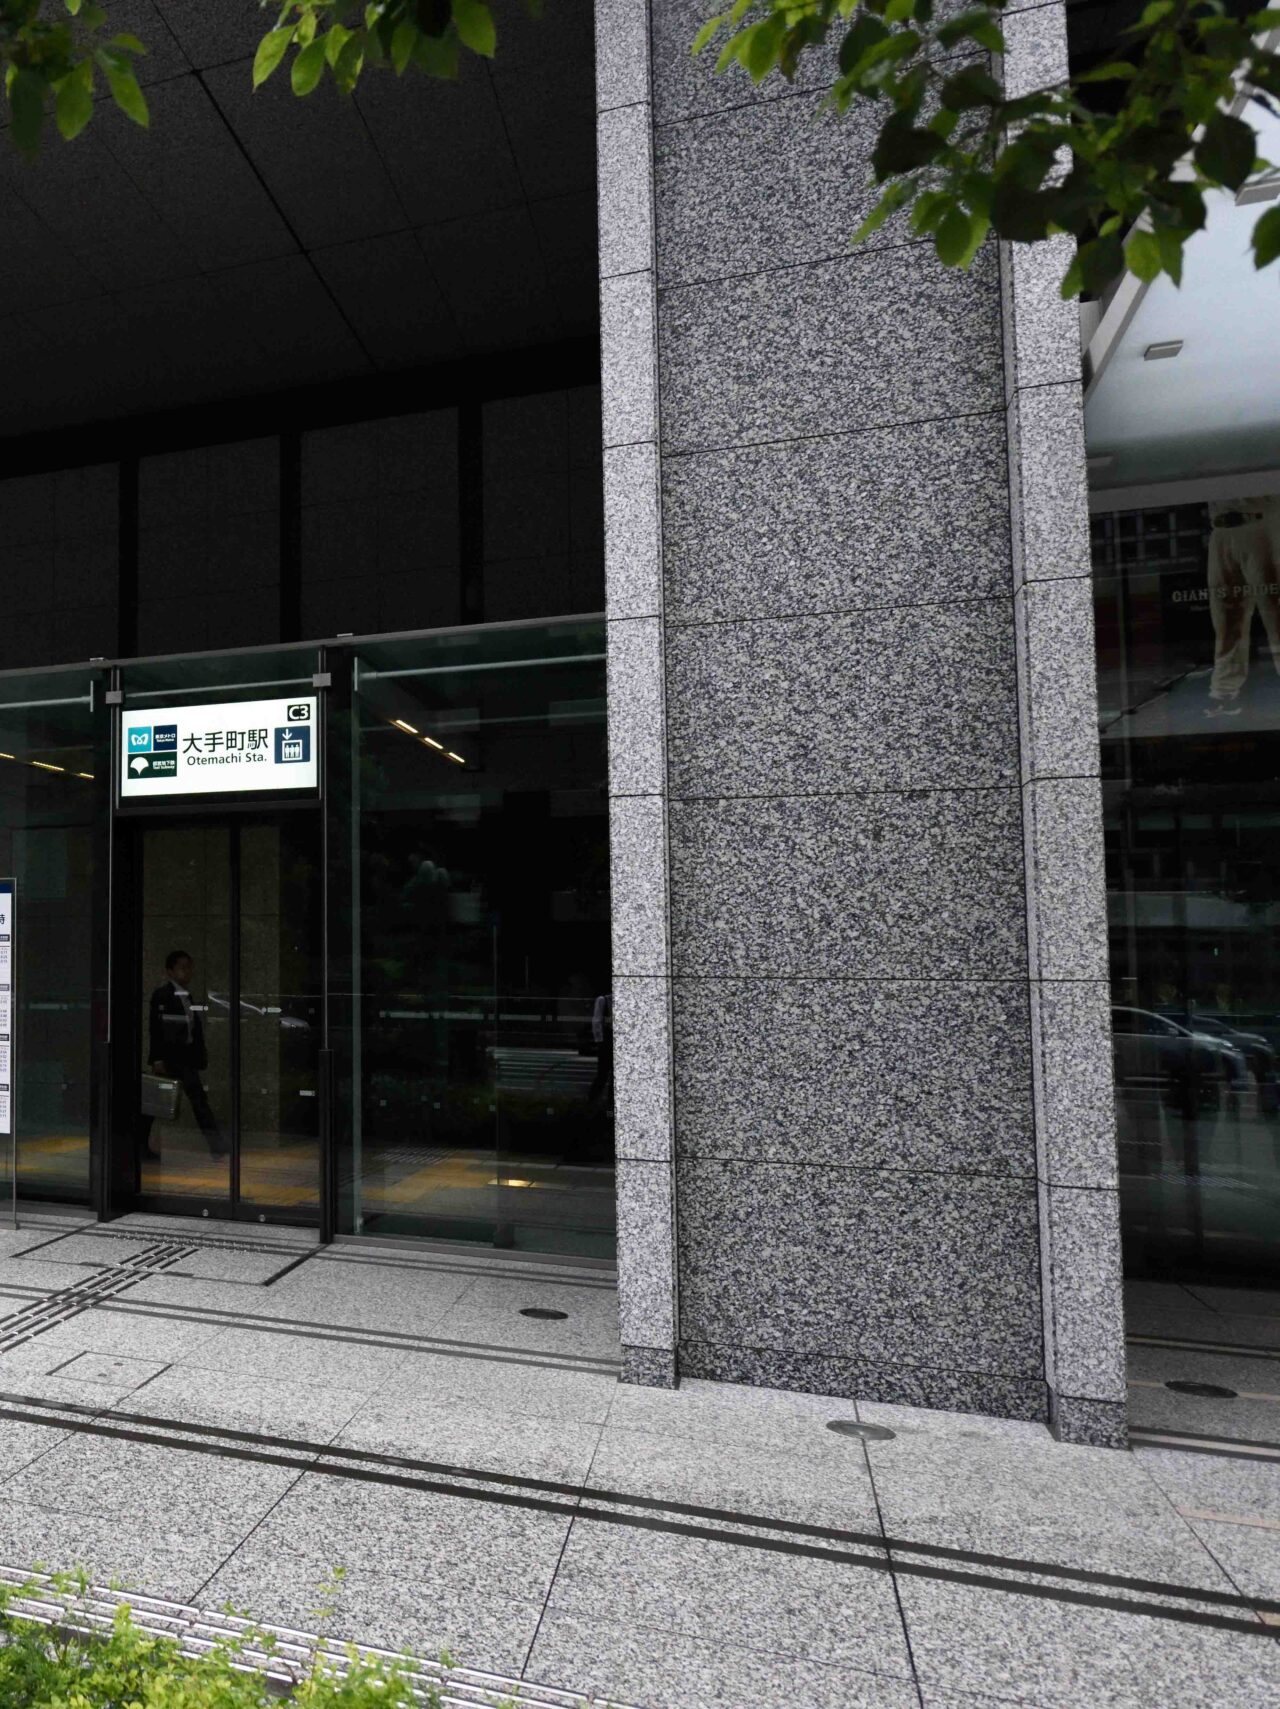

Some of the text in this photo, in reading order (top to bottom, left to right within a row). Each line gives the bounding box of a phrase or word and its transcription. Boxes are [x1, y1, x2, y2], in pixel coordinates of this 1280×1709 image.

[288, 705, 309, 720] C3
[183, 728, 268, 754] 大手町駅
[187, 752, 268, 766] Otemachi Sta.
